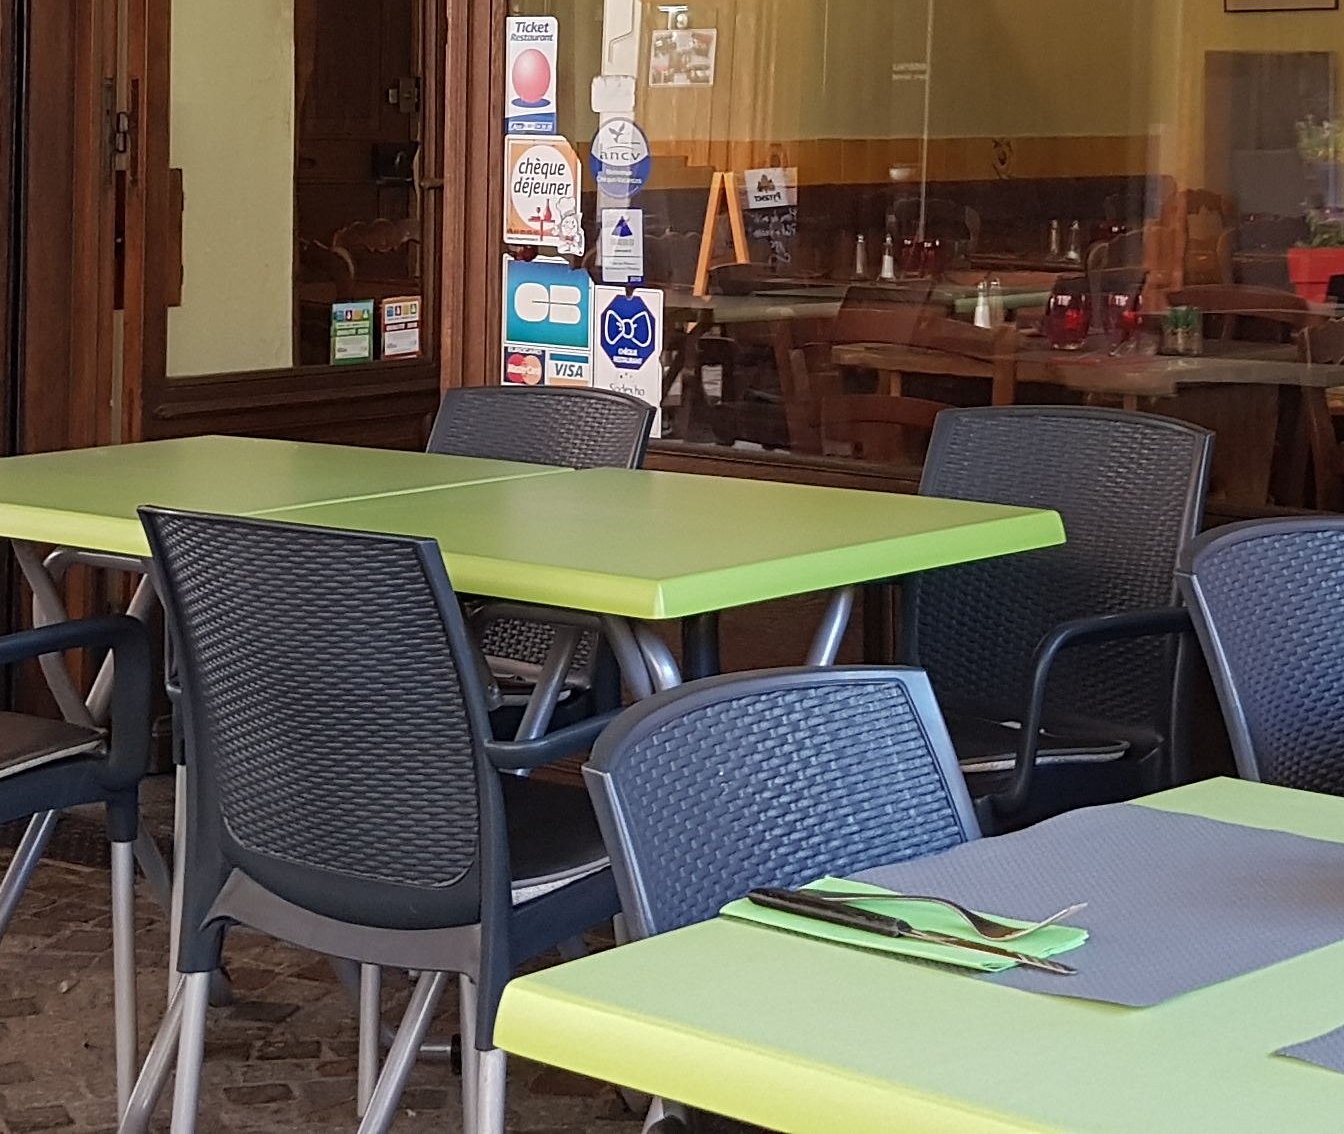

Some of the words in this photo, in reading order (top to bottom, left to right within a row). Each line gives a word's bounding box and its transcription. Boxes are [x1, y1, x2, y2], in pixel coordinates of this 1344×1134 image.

[515, 21, 549, 33] Ticket
[510, 33, 554, 41] Restaurant
[600, 151, 641, 161] ancv
[518, 157, 565, 179] chèque
[513, 177, 571, 198] déjeuner
[514, 282, 582, 324] CB
[555, 363, 583, 378] VISA
